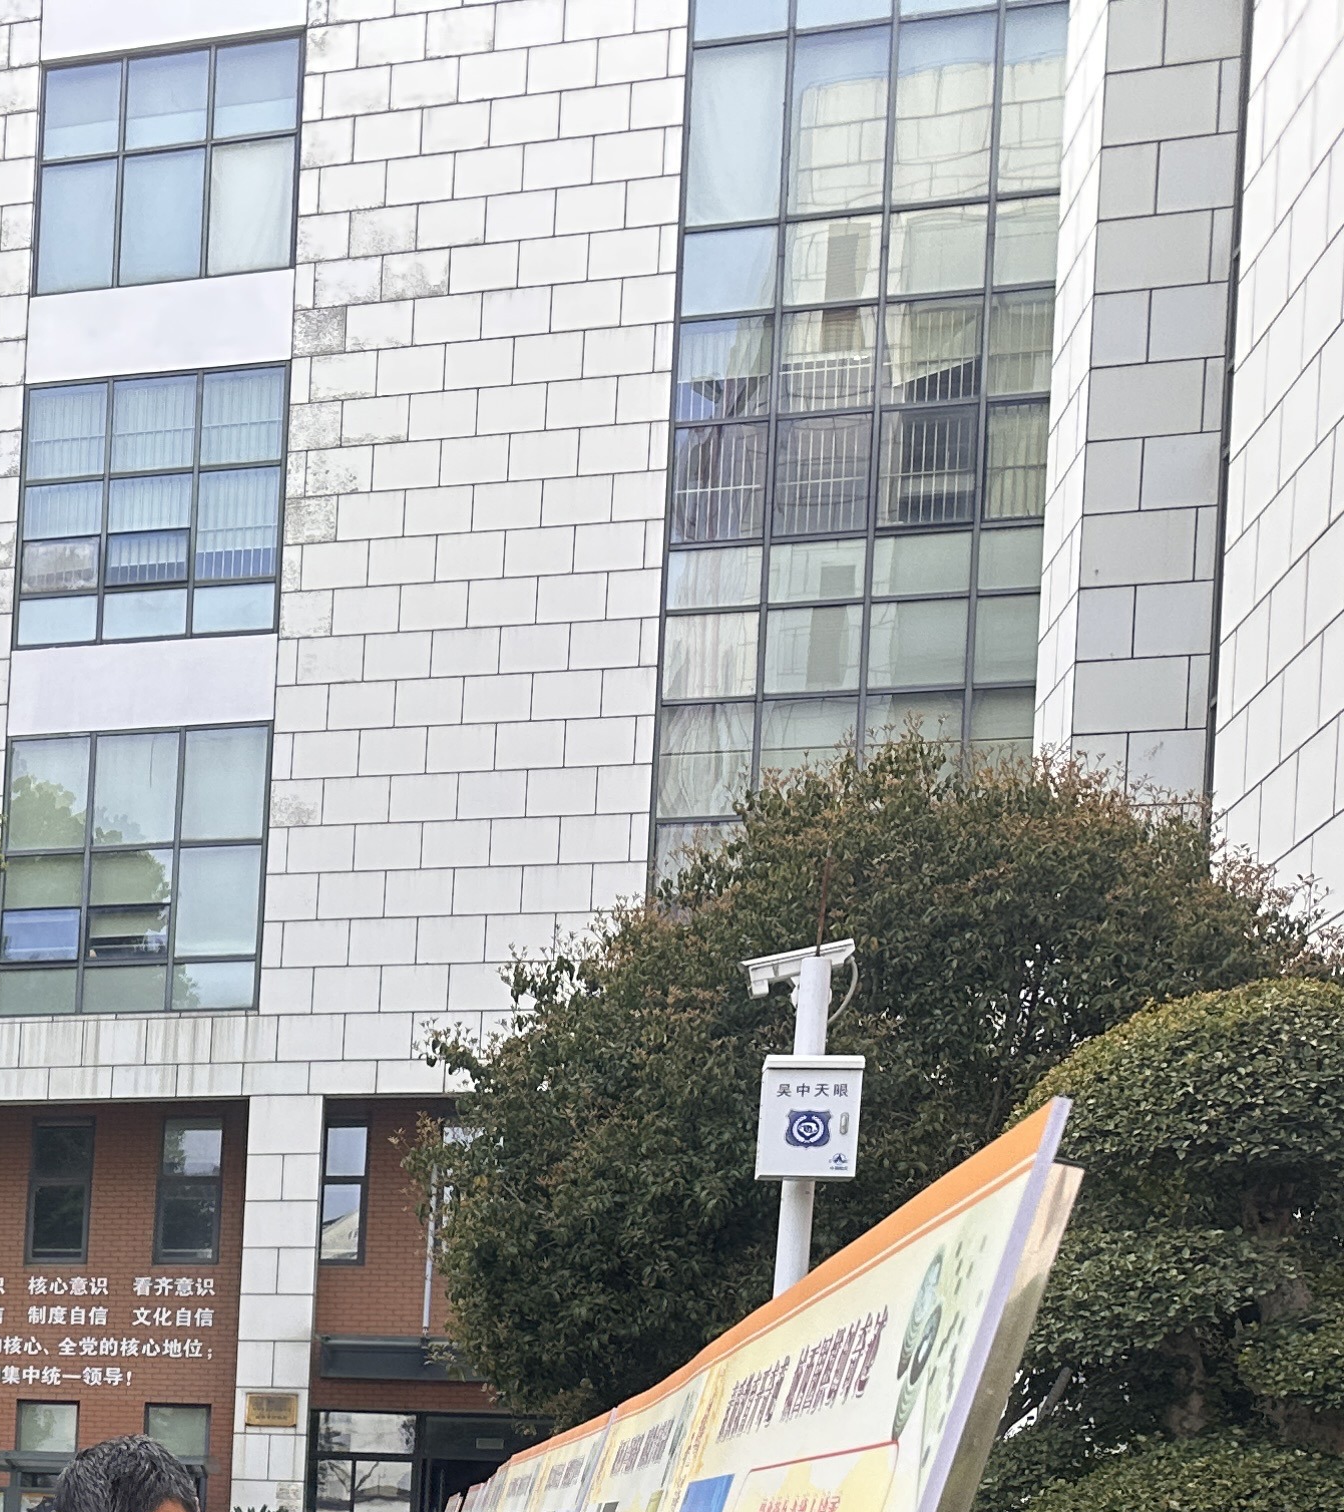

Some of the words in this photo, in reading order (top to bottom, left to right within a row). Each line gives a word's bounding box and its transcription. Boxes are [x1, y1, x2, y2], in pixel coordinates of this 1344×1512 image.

[777, 1083, 849, 1098] 吴中天眼
[28, 1276, 109, 1296] 核心意识
[133, 1277, 216, 1297] 看齐意识
[28, 1306, 109, 1326] 制度自信
[132, 1307, 215, 1328] 文化自信
